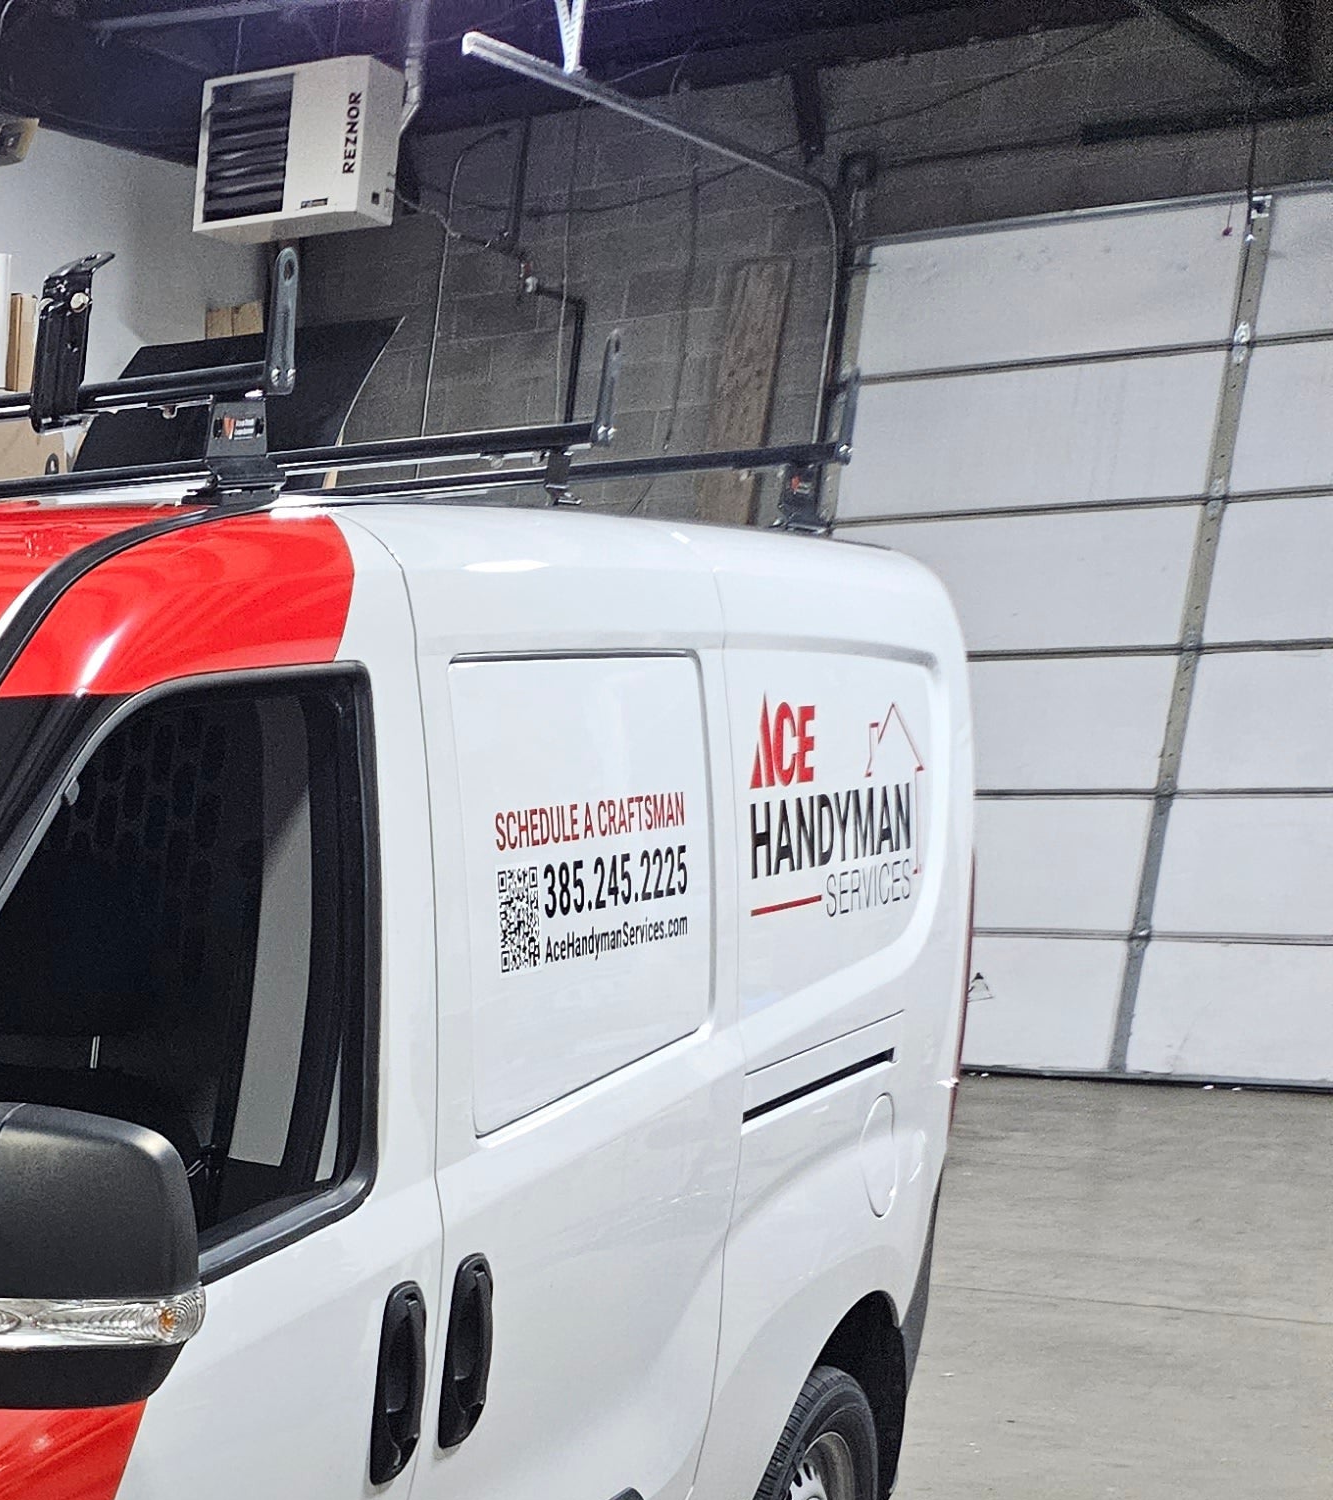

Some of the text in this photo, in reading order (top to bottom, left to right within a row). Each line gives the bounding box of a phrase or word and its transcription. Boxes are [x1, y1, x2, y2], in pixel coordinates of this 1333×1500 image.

[342, 91, 362, 174] REZNOR
[749, 690, 815, 789] ACE
[495, 792, 685, 851] SCHEDULE A CRAFTSMAN
[750, 782, 911, 880] HANDYMAN
[543, 844, 688, 918] 385.245.2225
[826, 858, 912, 918] SERVICES
[545, 915, 688, 963] AceHandymanServices.com
